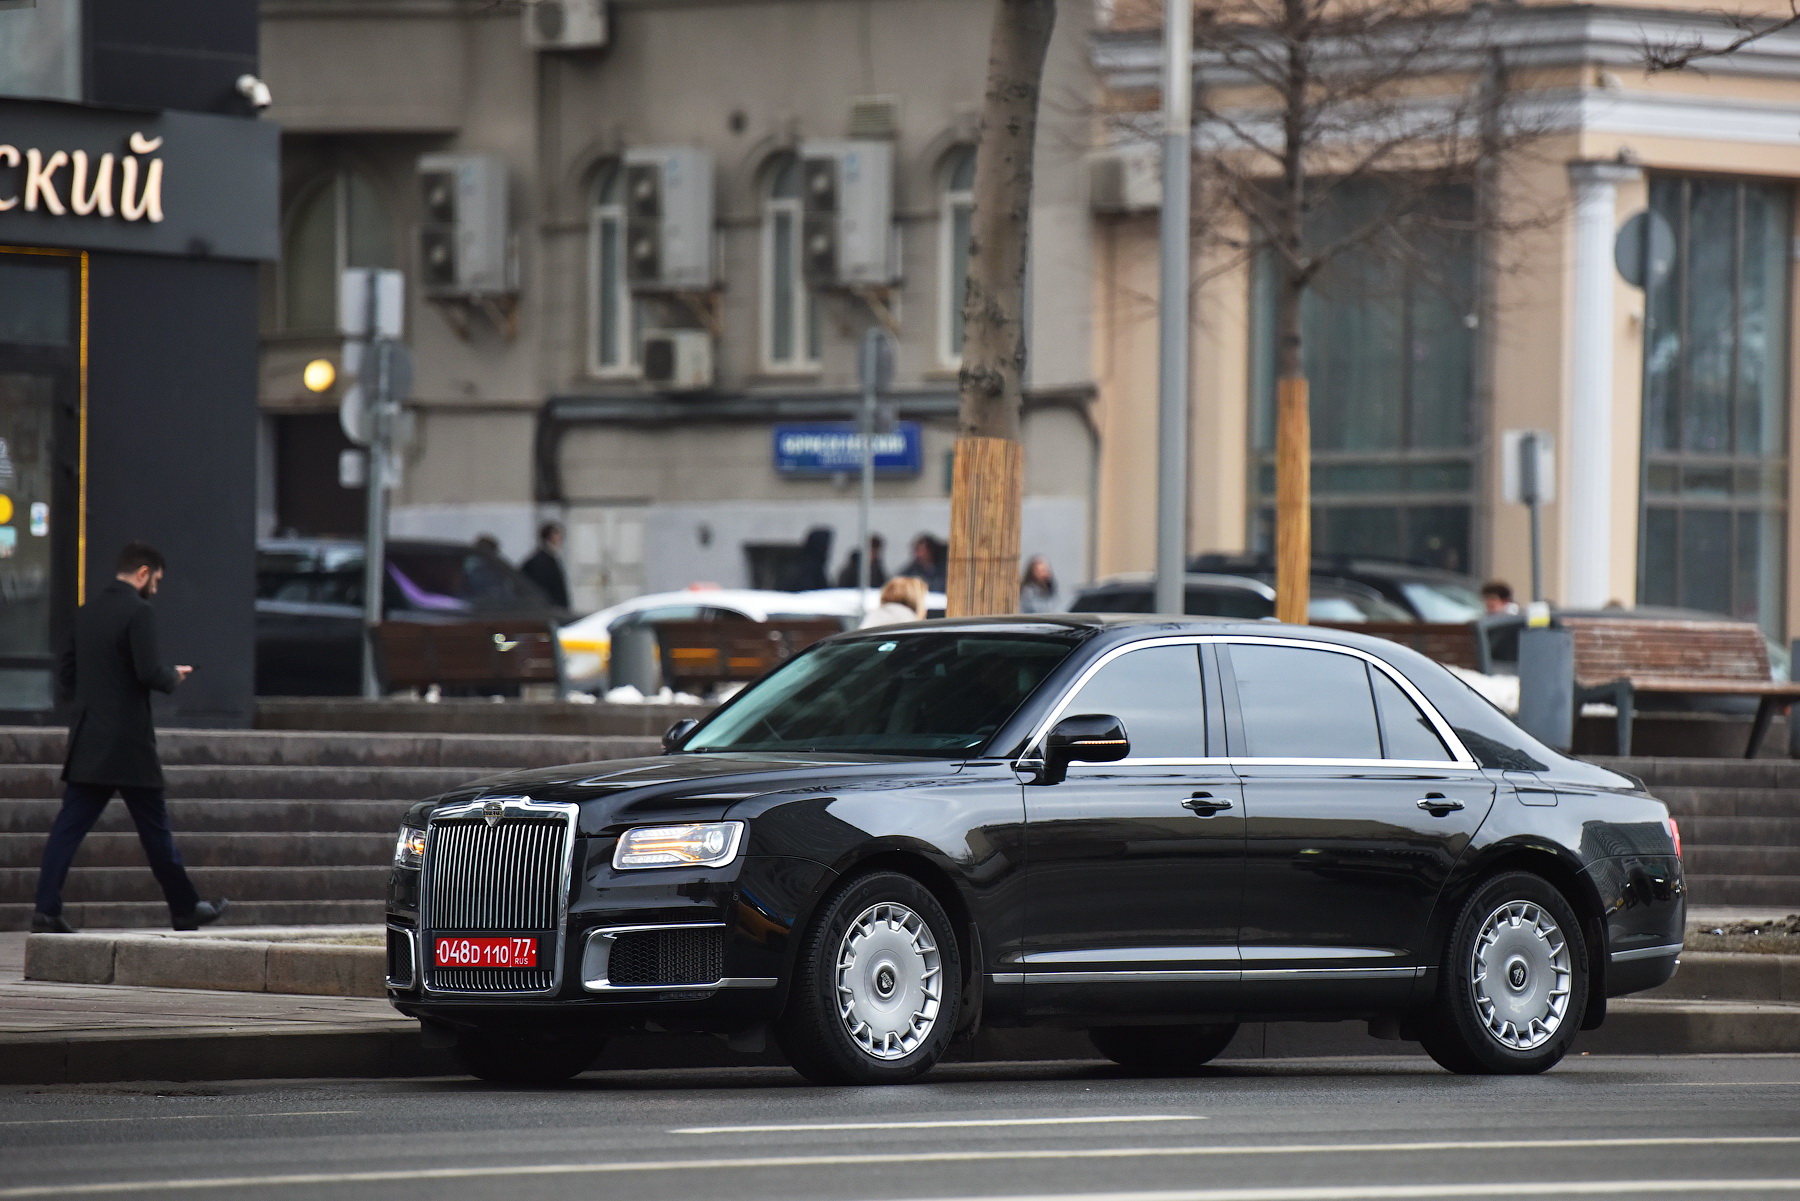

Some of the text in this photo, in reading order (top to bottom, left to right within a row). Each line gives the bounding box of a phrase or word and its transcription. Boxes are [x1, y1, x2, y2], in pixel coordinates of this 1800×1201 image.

[0, 131, 164, 223] ский
[440, 940, 509, 964] 048D 110
[513, 939, 531, 957] 77
